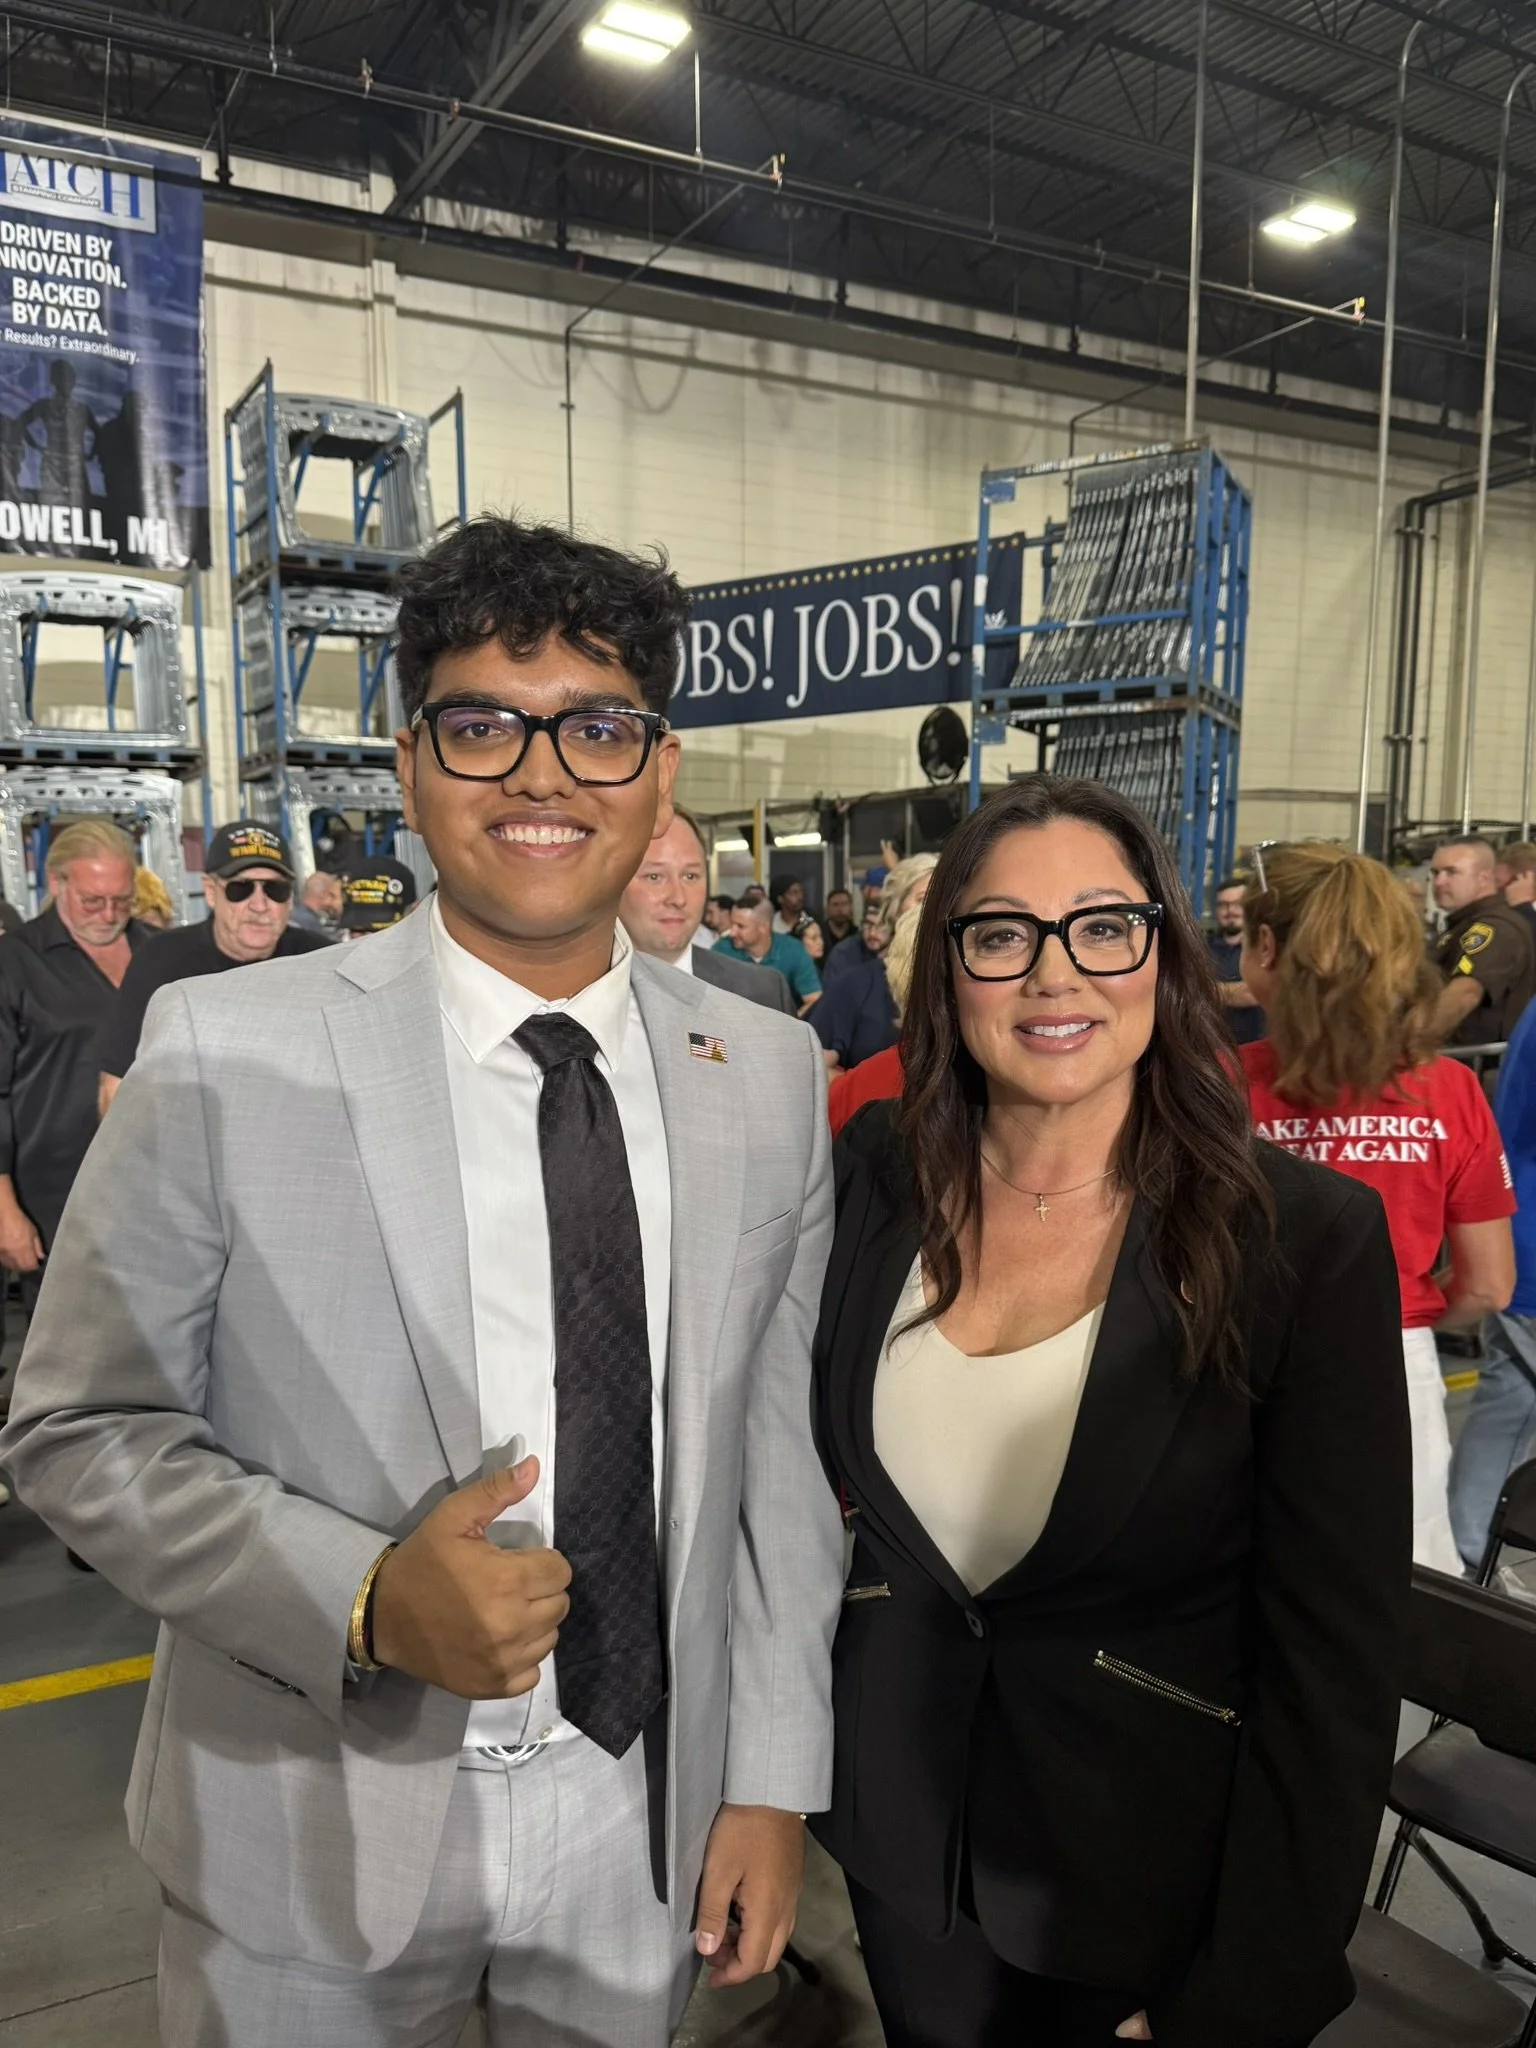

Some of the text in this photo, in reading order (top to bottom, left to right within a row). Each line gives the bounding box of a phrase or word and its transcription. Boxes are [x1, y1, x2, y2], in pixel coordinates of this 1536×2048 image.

[0, 220, 112, 261] DRIVEN BY
[12, 276, 101, 310] BACKED
[12, 301, 109, 336] BY DATA.
[4, 327, 58, 349] Results?
[60, 335, 140, 366] Extraordinary.
[0, 500, 119, 556] OWELL,
[786, 577, 963, 708] JOBS!
[1311, 1115, 1449, 1140] AMERICA
[1337, 1140, 1431, 1163] AGAIN
